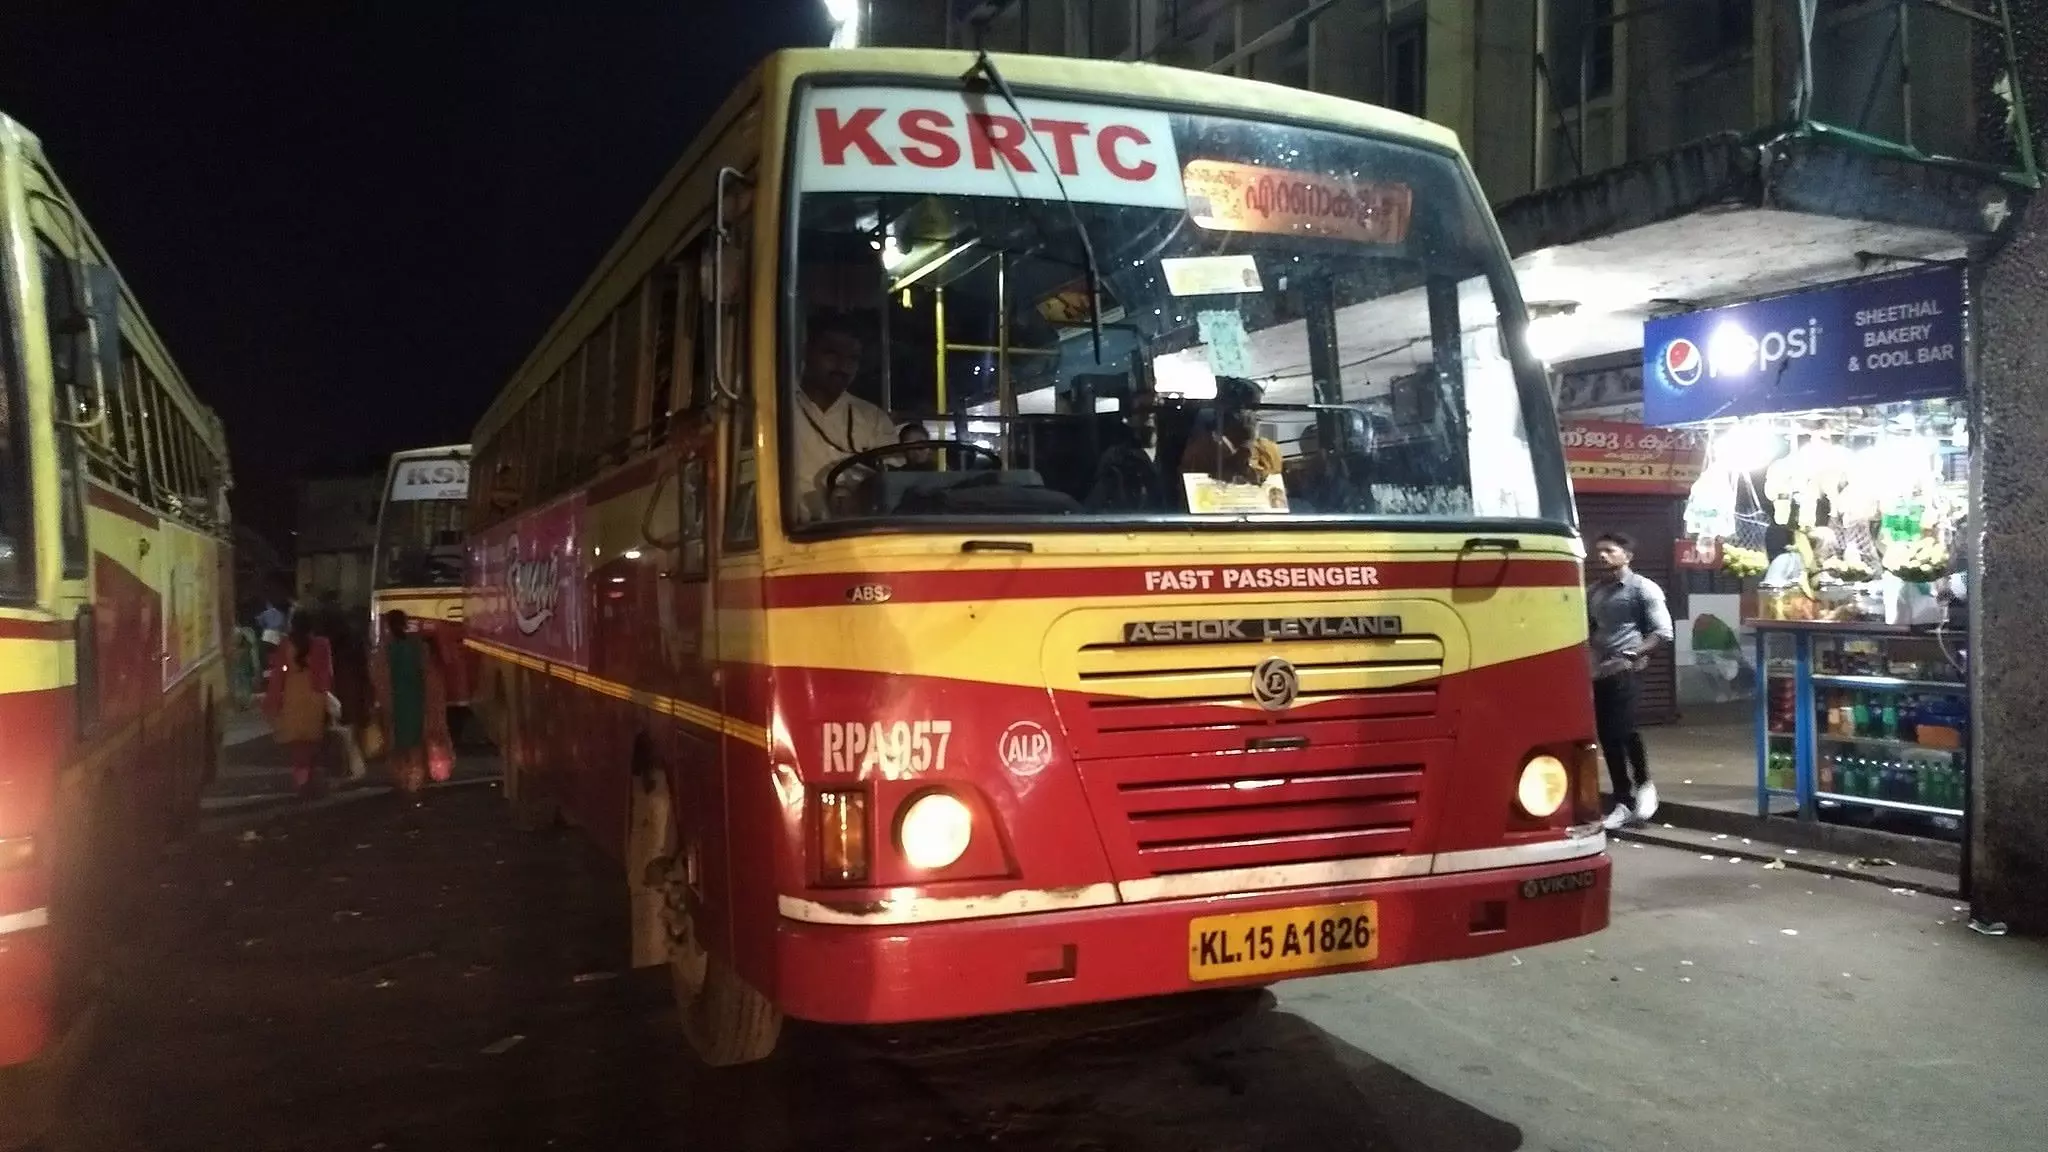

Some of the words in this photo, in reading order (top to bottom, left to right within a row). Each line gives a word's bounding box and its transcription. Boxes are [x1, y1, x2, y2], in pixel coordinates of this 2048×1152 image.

[815, 107, 1157, 182] KSRTC
[1855, 300, 1942, 326] SHEETHAL
[1707, 318, 1818, 378] psi
[1863, 323, 1932, 348] BAKERY
[1847, 356, 1860, 372] &
[1866, 349, 1914, 370] COOL
[1917, 344, 1954, 363] BAR
[1145, 569, 1214, 591] FAST
[1222, 566, 1379, 589] PASSENGER
[852, 585, 885, 602] ABS
[1129, 619, 1246, 643] ASHOK
[1263, 616, 1400, 638] LEYLAND
[1008, 735, 1046, 763] ALP
[1200, 925, 1274, 966] KL.15
[1282, 915, 1370, 957] A1826
